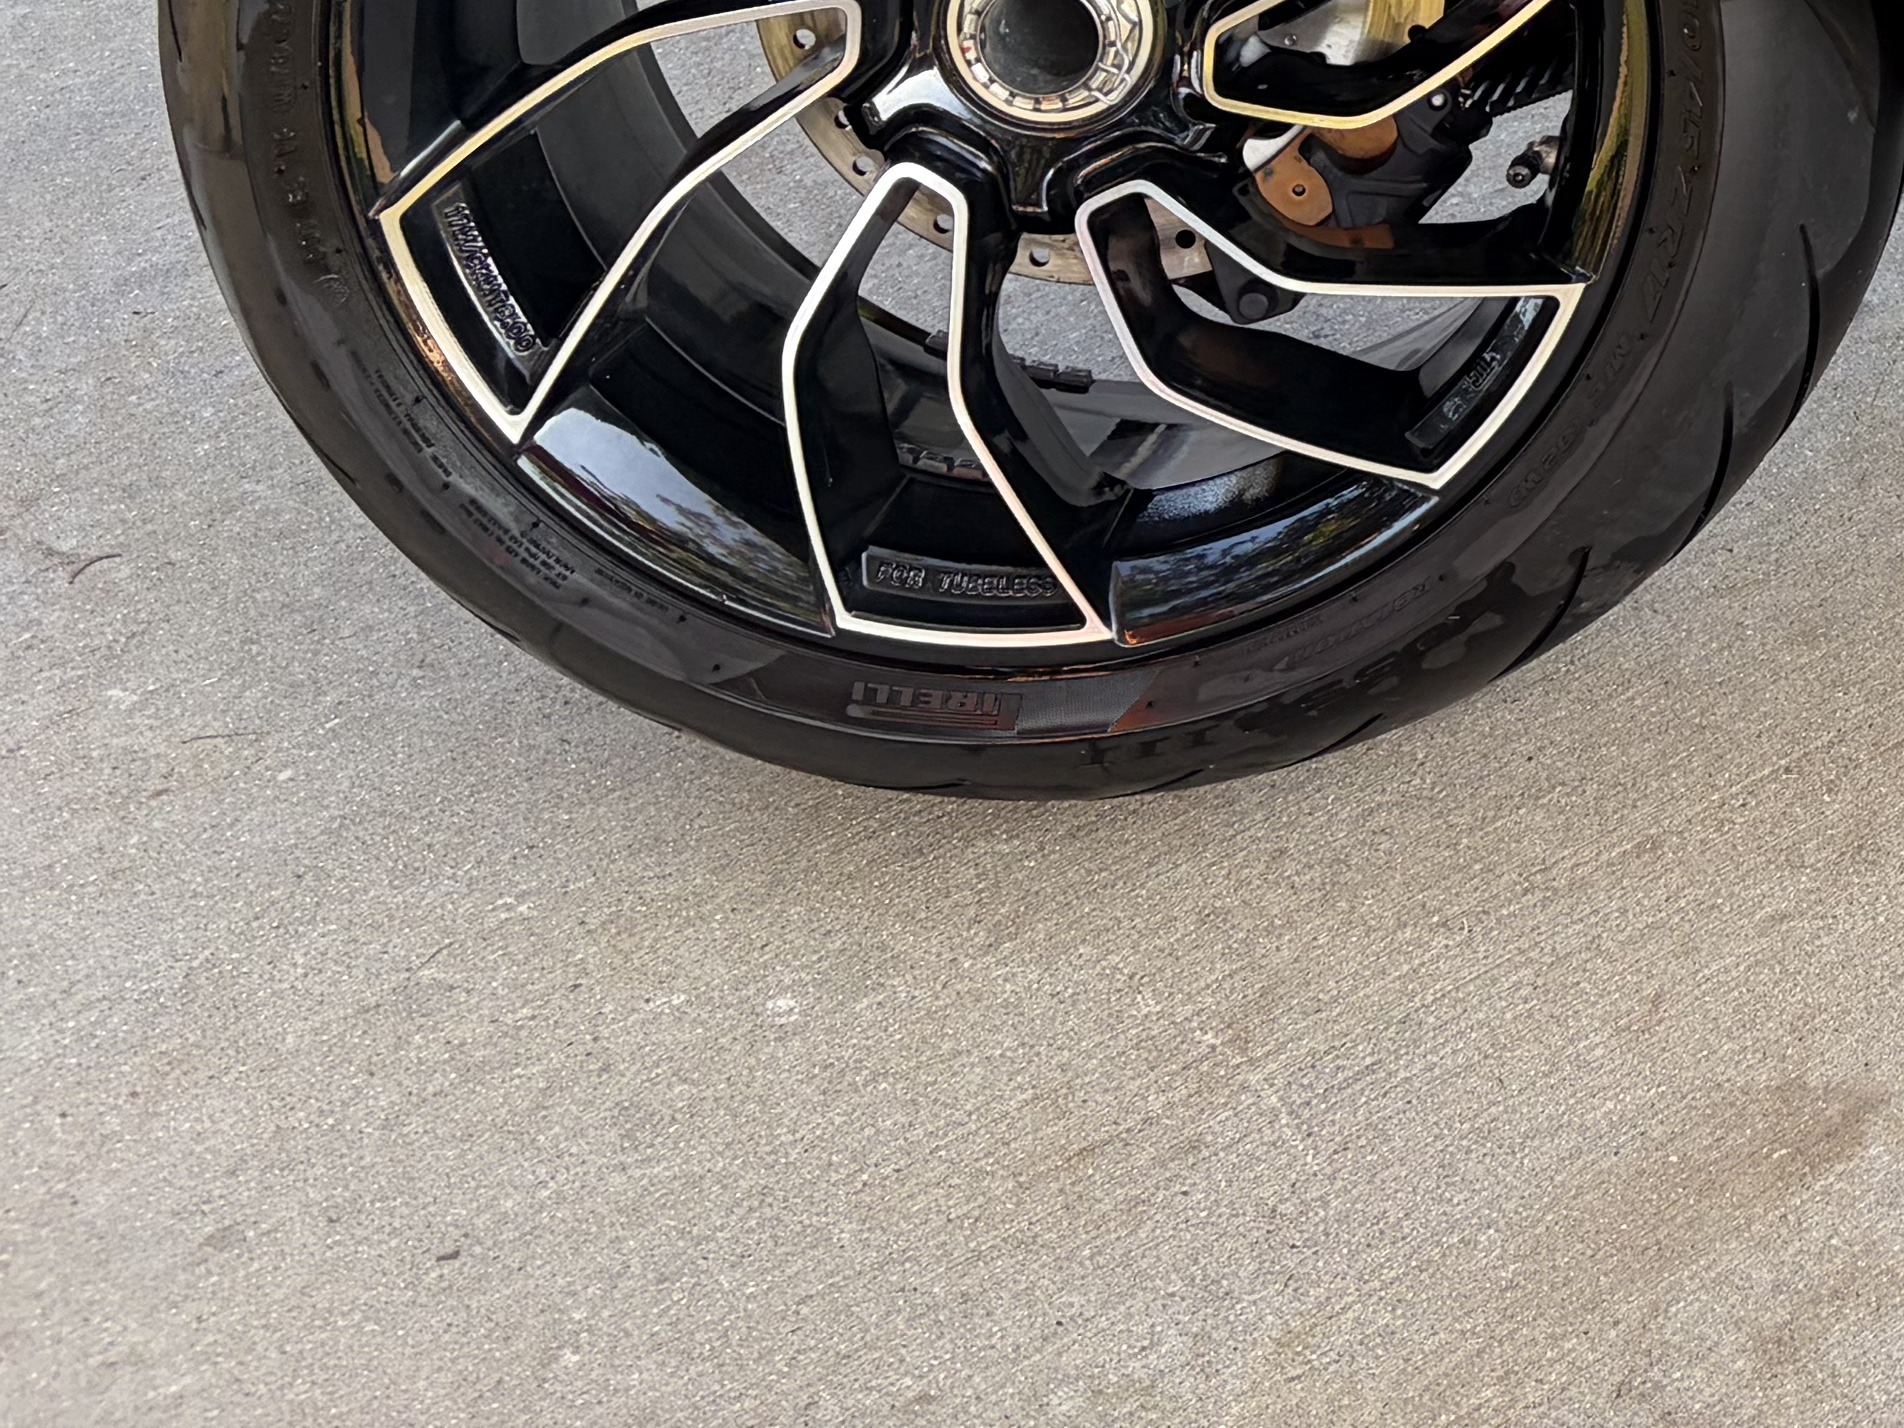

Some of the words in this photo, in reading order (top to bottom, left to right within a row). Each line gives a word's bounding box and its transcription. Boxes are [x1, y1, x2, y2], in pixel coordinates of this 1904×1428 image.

[875, 561, 926, 590] FOR
[938, 571, 1060, 598] TUBELESS
[850, 679, 1024, 732] PIRELLI
